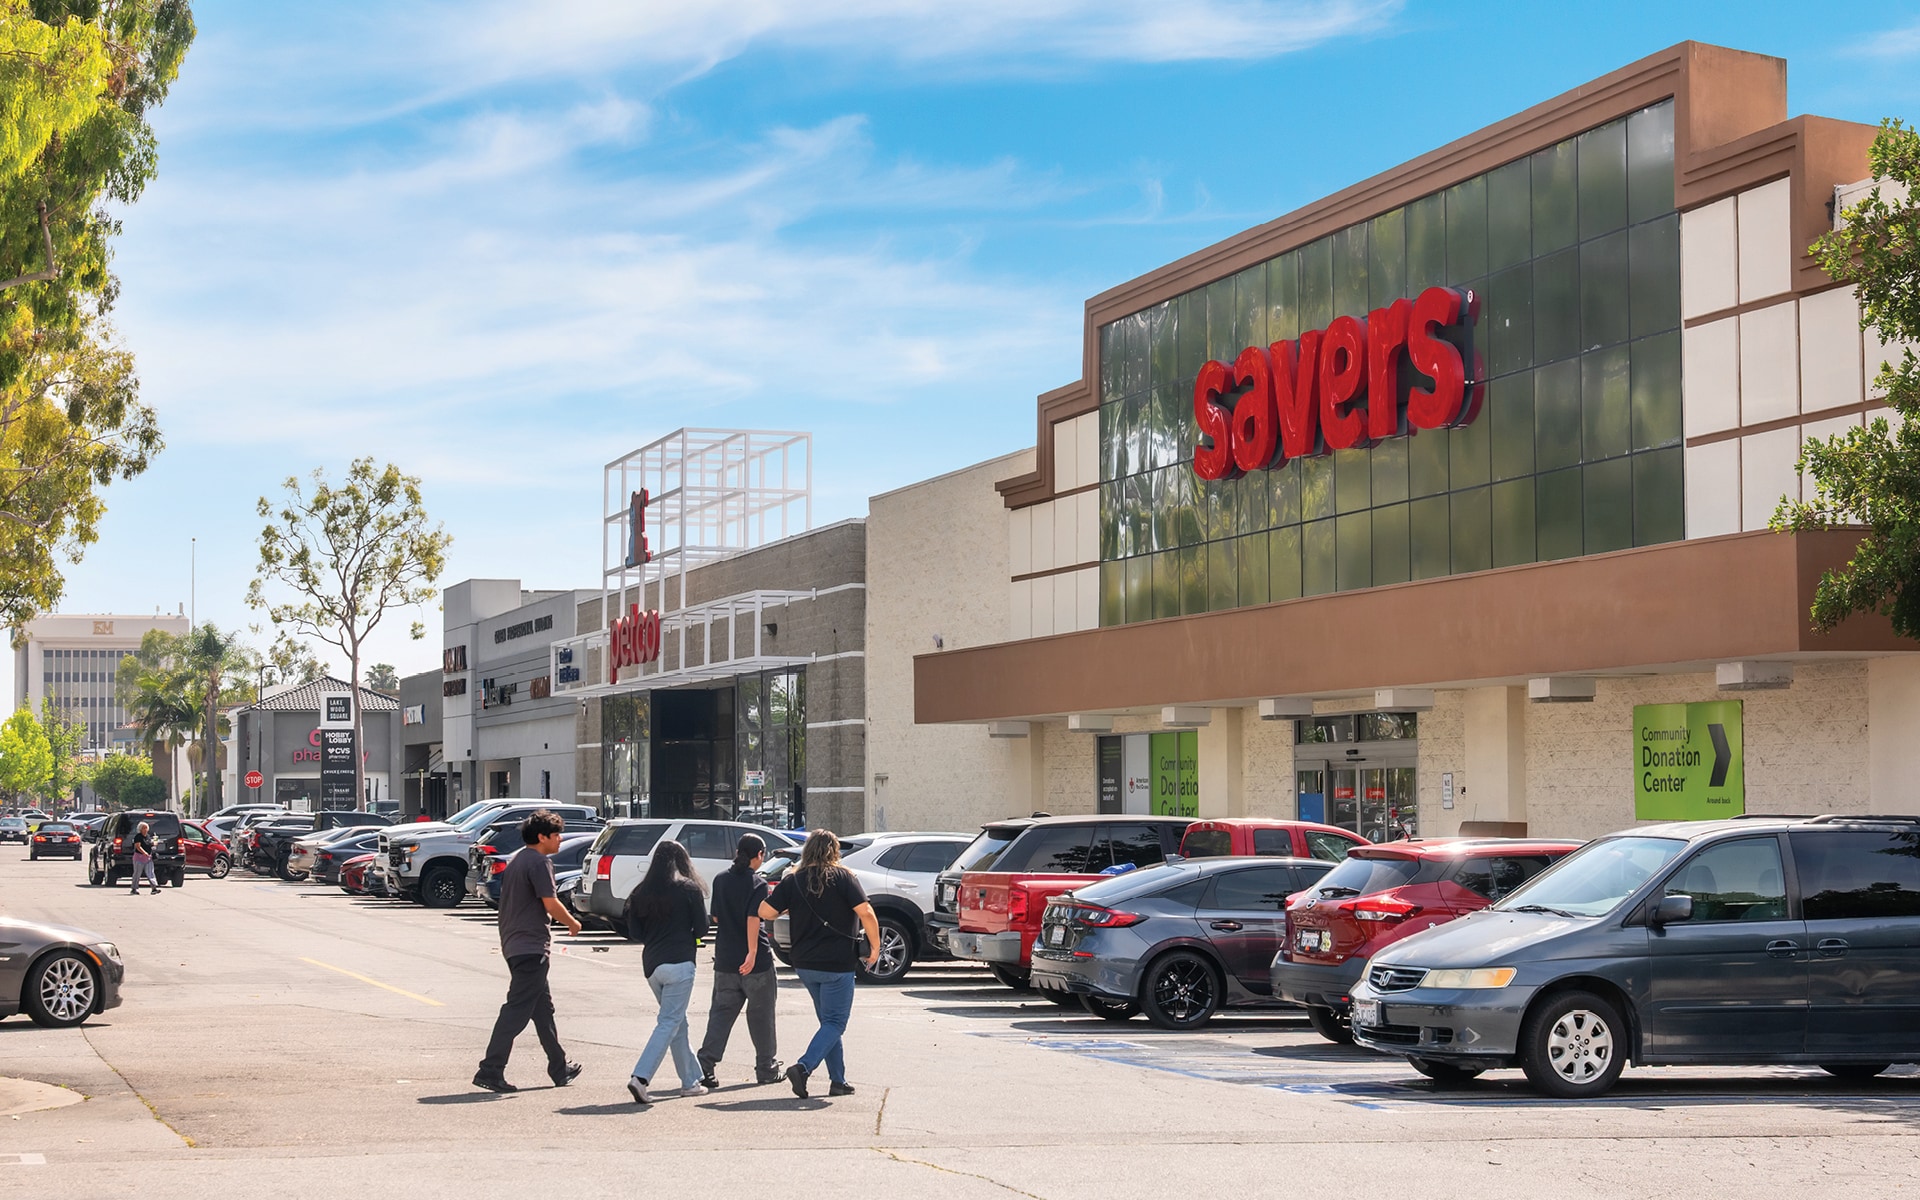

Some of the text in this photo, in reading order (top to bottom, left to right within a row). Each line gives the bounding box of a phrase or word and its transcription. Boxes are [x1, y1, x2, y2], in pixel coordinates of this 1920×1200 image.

[1193, 286, 1464, 481] savers
[610, 603, 660, 685] petco
[1641, 725, 1691, 744] Community
[293, 747, 369, 765] phay
[1160, 755, 1197, 774] Comunity
[1642, 745, 1701, 768] Donation
[246, 775, 262, 785] STOP
[1643, 771, 1687, 793] Center
[1706, 796, 1731, 804] Around back
